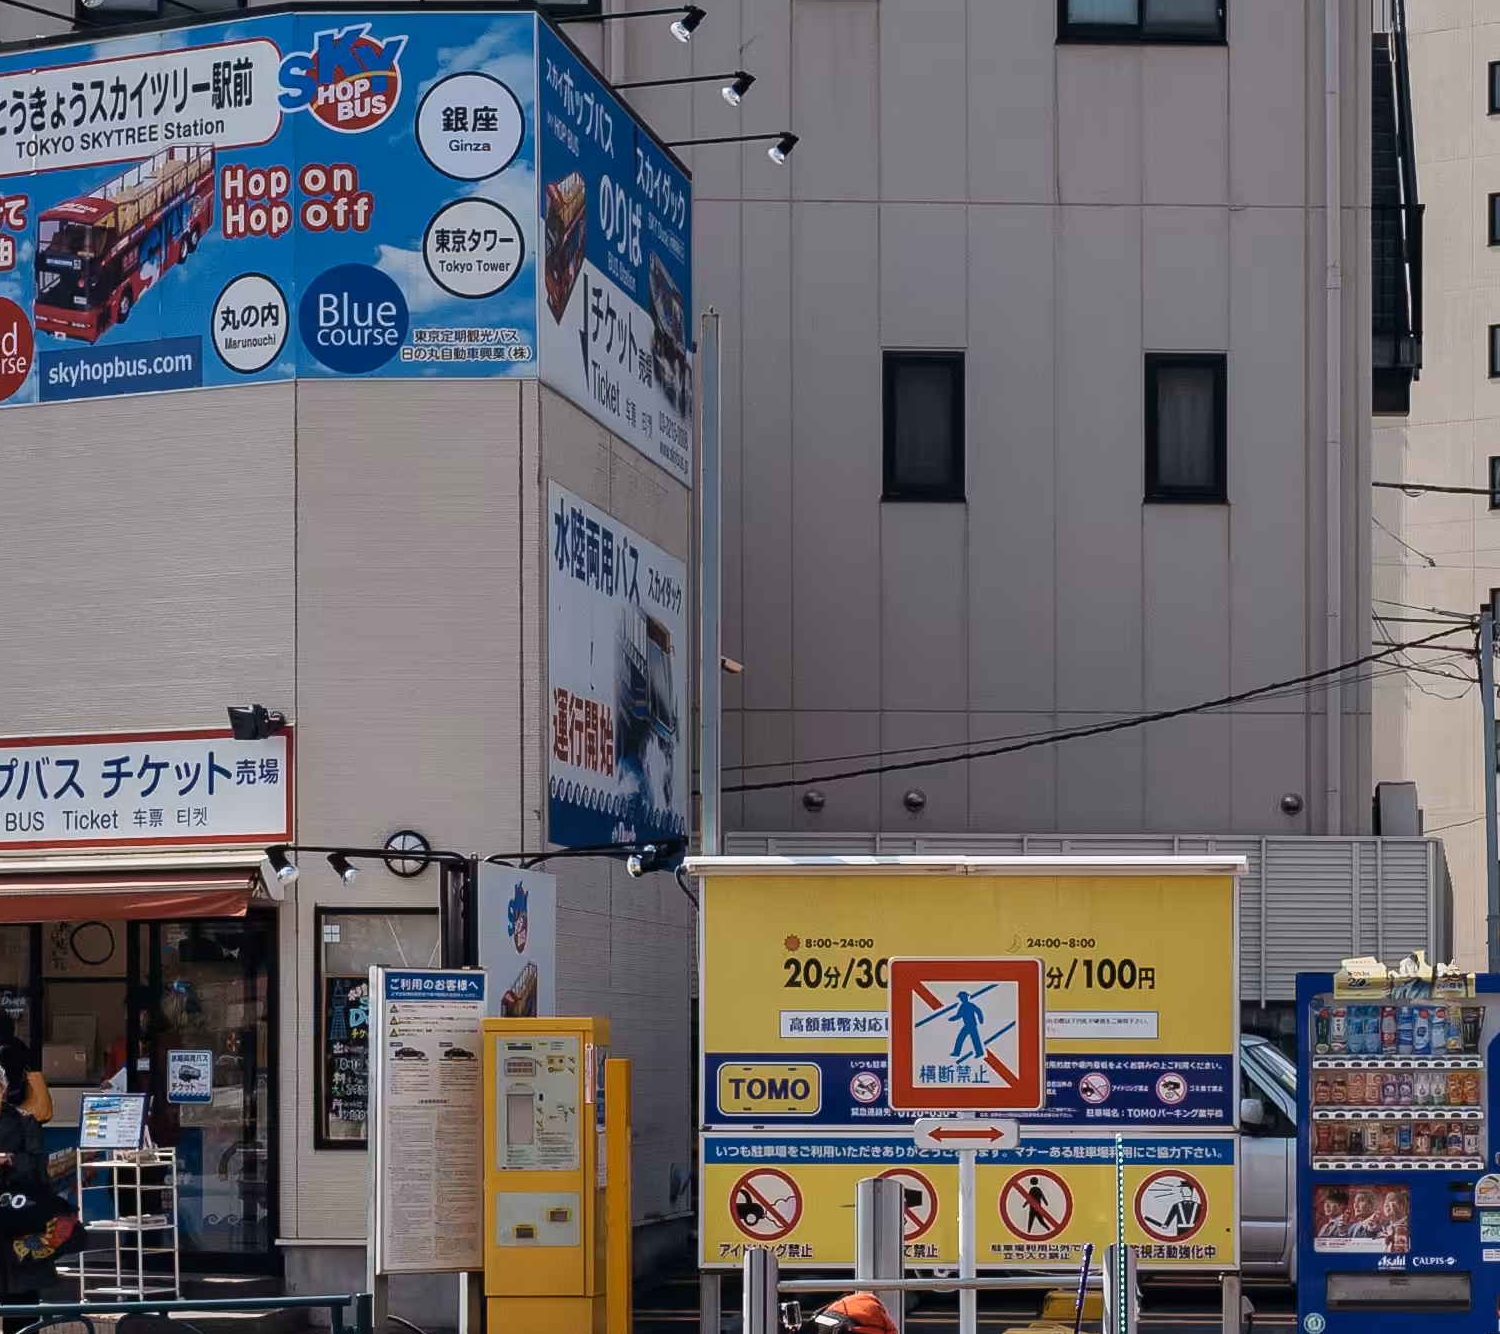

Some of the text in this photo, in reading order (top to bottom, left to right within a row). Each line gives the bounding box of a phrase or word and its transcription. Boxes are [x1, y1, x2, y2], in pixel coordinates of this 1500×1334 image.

[279, 24, 407, 112] SKY
[317, 78, 369, 106] HOP
[337, 96, 387, 121] BUS
[441, 106, 499, 134] 銀座
[16, 118, 225, 160] TOKYO SKYTREE Station
[448, 139, 492, 153] Ginza
[224, 167, 354, 199] Hop on
[225, 197, 369, 235] Hop off
[599, 173, 643, 268] のりば
[434, 228, 515, 255] 東京タワー
[439, 260, 511, 276] Tokyo Tower
[219, 302, 280, 332] 丸の内
[318, 292, 397, 328] Blue
[224, 335, 276, 351] Marunouchi
[316, 325, 398, 347] course
[412, 328, 519, 343] 東京定期観光バス
[48, 352, 193, 391] skyhopbus.com
[592, 359, 621, 417] Ticket
[554, 497, 641, 604] 水陸両用バス
[647, 567, 683, 617] スカイダック
[552, 686, 614, 779] 運行開始
[101, 750, 280, 799] チケット売場
[5, 811, 45, 833] BUS
[63, 809, 119, 831] Ticket
[389, 977, 480, 991] ご利用のお客様へ
[788, 1016, 889, 1034] 高額紙幣対応
[919, 1063, 991, 1085] 横断禁止
[728, 1077, 811, 1101] TOMO
[1377, 1255, 1445, 1267] Asahi CALPIS
